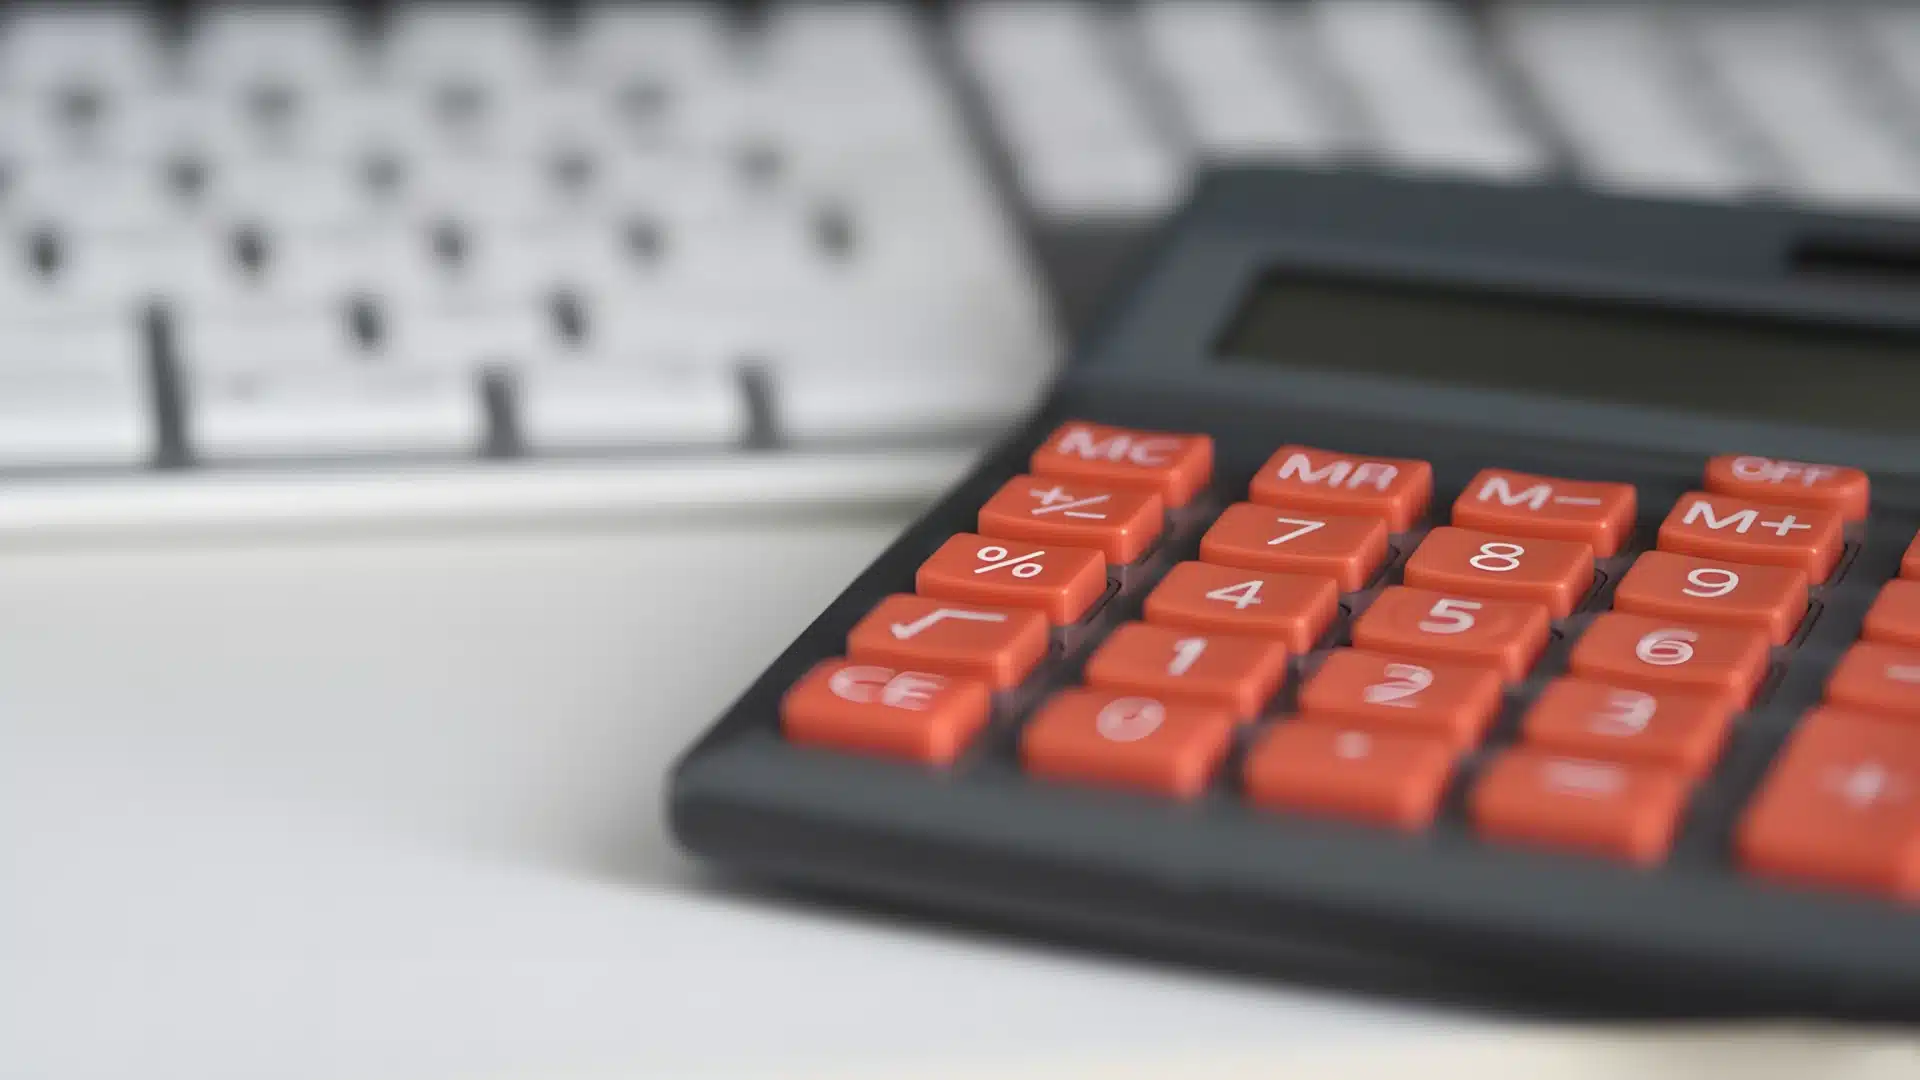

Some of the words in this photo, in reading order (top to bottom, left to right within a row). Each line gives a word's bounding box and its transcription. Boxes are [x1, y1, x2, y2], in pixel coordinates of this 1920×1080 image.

[1057, 427, 1182, 465] MC
[1277, 453, 1398, 490] MR
[1730, 456, 1836, 487] OFF
[1267, 517, 1326, 545] 7
[1682, 500, 1811, 536] M+
[973, 545, 1045, 578] %
[1469, 542, 1525, 572] 8
[1205, 579, 1264, 610] 4
[1682, 567, 1740, 598] 9
[1417, 597, 1483, 634] 5
[1167, 636, 1209, 677] 1
[1634, 628, 1699, 665] 6
[828, 664, 946, 711] CE
[1362, 662, 1434, 709] 2
[1095, 695, 1166, 742] 0
[1590, 690, 1657, 737] 3
